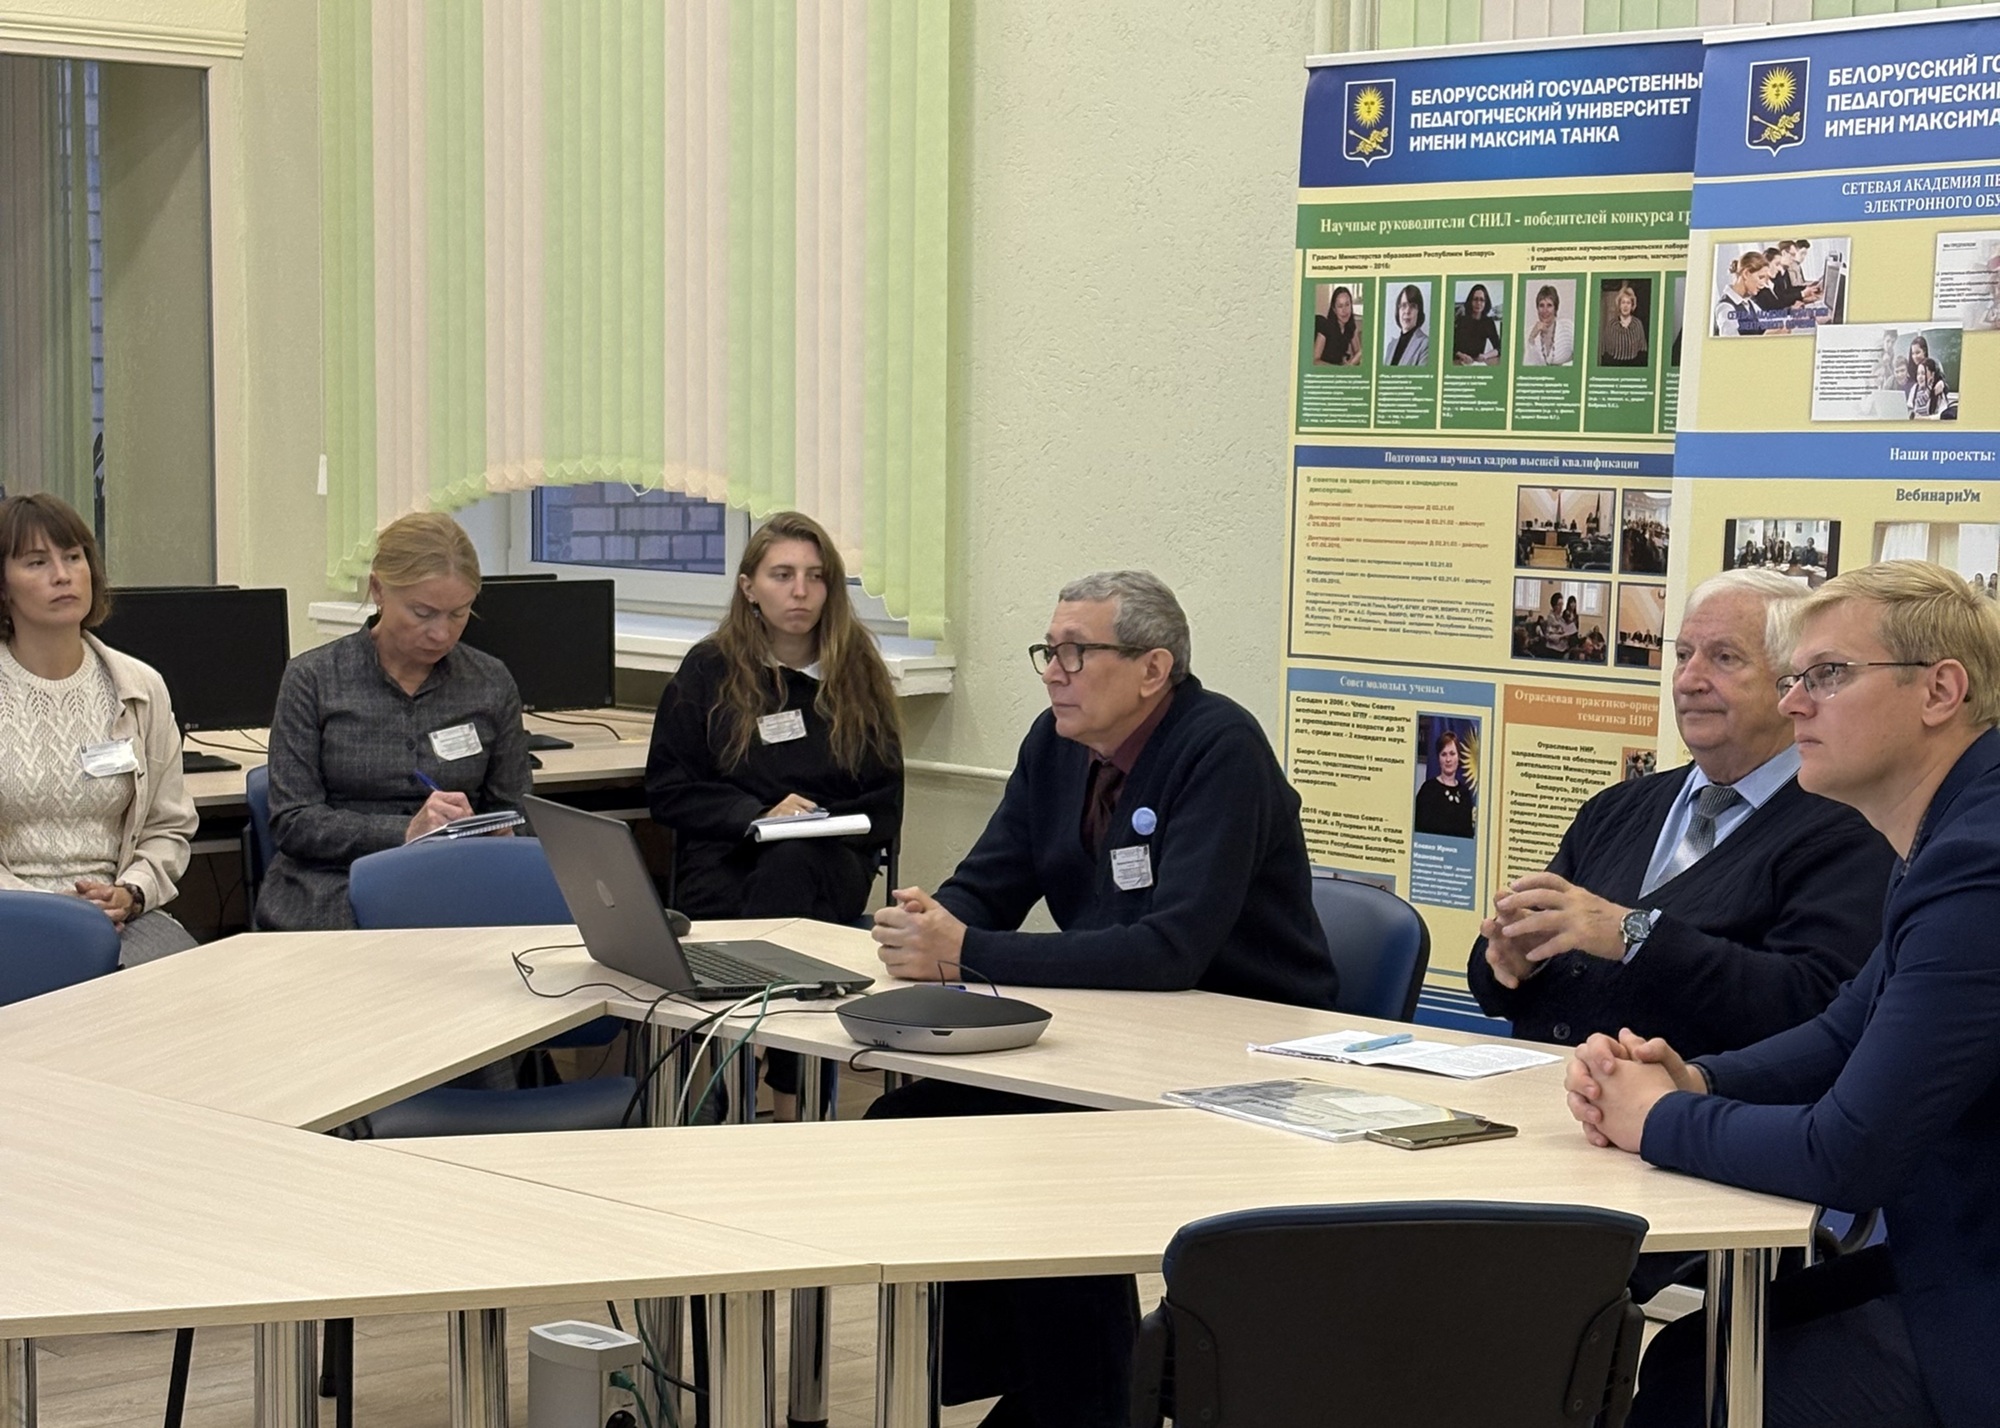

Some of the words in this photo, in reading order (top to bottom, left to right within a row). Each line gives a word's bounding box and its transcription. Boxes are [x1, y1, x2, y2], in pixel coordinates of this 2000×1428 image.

[1828, 54, 1978, 86] БЕЛОРУССКИЙ
[1412, 80, 1534, 106] БЕЛОРУССКИЙ
[1538, 72, 1702, 98] ГОСУДАРСТВЕННЫ
[1826, 80, 2000, 112] ПЕДАГОГИЧЕСКИ
[1410, 100, 1562, 129] ПЕДАГОГИЧЕСКИЙ
[1566, 98, 1690, 120] УНИВЕРСИТЕТ
[1824, 117, 1894, 138] ИМЕНИ
[1899, 108, 2000, 133] МАКСИМА
[1409, 132, 1466, 152] ИМЕНИ
[1470, 128, 1556, 149] МАКСИМА
[1561, 125, 1620, 144] ТАНКА
[1842, 180, 1901, 195] СЕТЕВАЯ
[1904, 174, 1981, 193] АКАДЕМИЯ
[1864, 195, 1973, 214] ЭЛЕКТРОННОГО
[1320, 218, 1376, 235] Научные
[1380, 215, 1466, 234] руководители
[1469, 212, 1512, 228] СНИЛ
[1523, 210, 1607, 227] победителей
[1611, 210, 1674, 226] конкурса
[1464, 249, 1495, 257] Беларусь
[1385, 452, 1438, 464] Подготовка
[1440, 455, 1481, 466] научных
[1484, 456, 1518, 468] кадров
[1520, 456, 1559, 466] высшей
[1562, 458, 1640, 470] квалификации
[1890, 448, 1928, 461] Наши
[1932, 449, 1996, 464] проекты:
[1896, 488, 1980, 505] ВебинариУм
[1340, 676, 1364, 688] Совет
[1366, 681, 1406, 691] молодых
[1409, 684, 1445, 694] ученых
[1372, 702, 1395, 710] Совета
[1515, 689, 1573, 705] Отраслевая
[1577, 712, 1626, 725] тематика
[1630, 715, 1654, 726] НИР
[1512, 750, 1560, 760] направленные
[1537, 741, 1578, 751] Отраслевые
[1565, 776, 1605, 786] Республики
